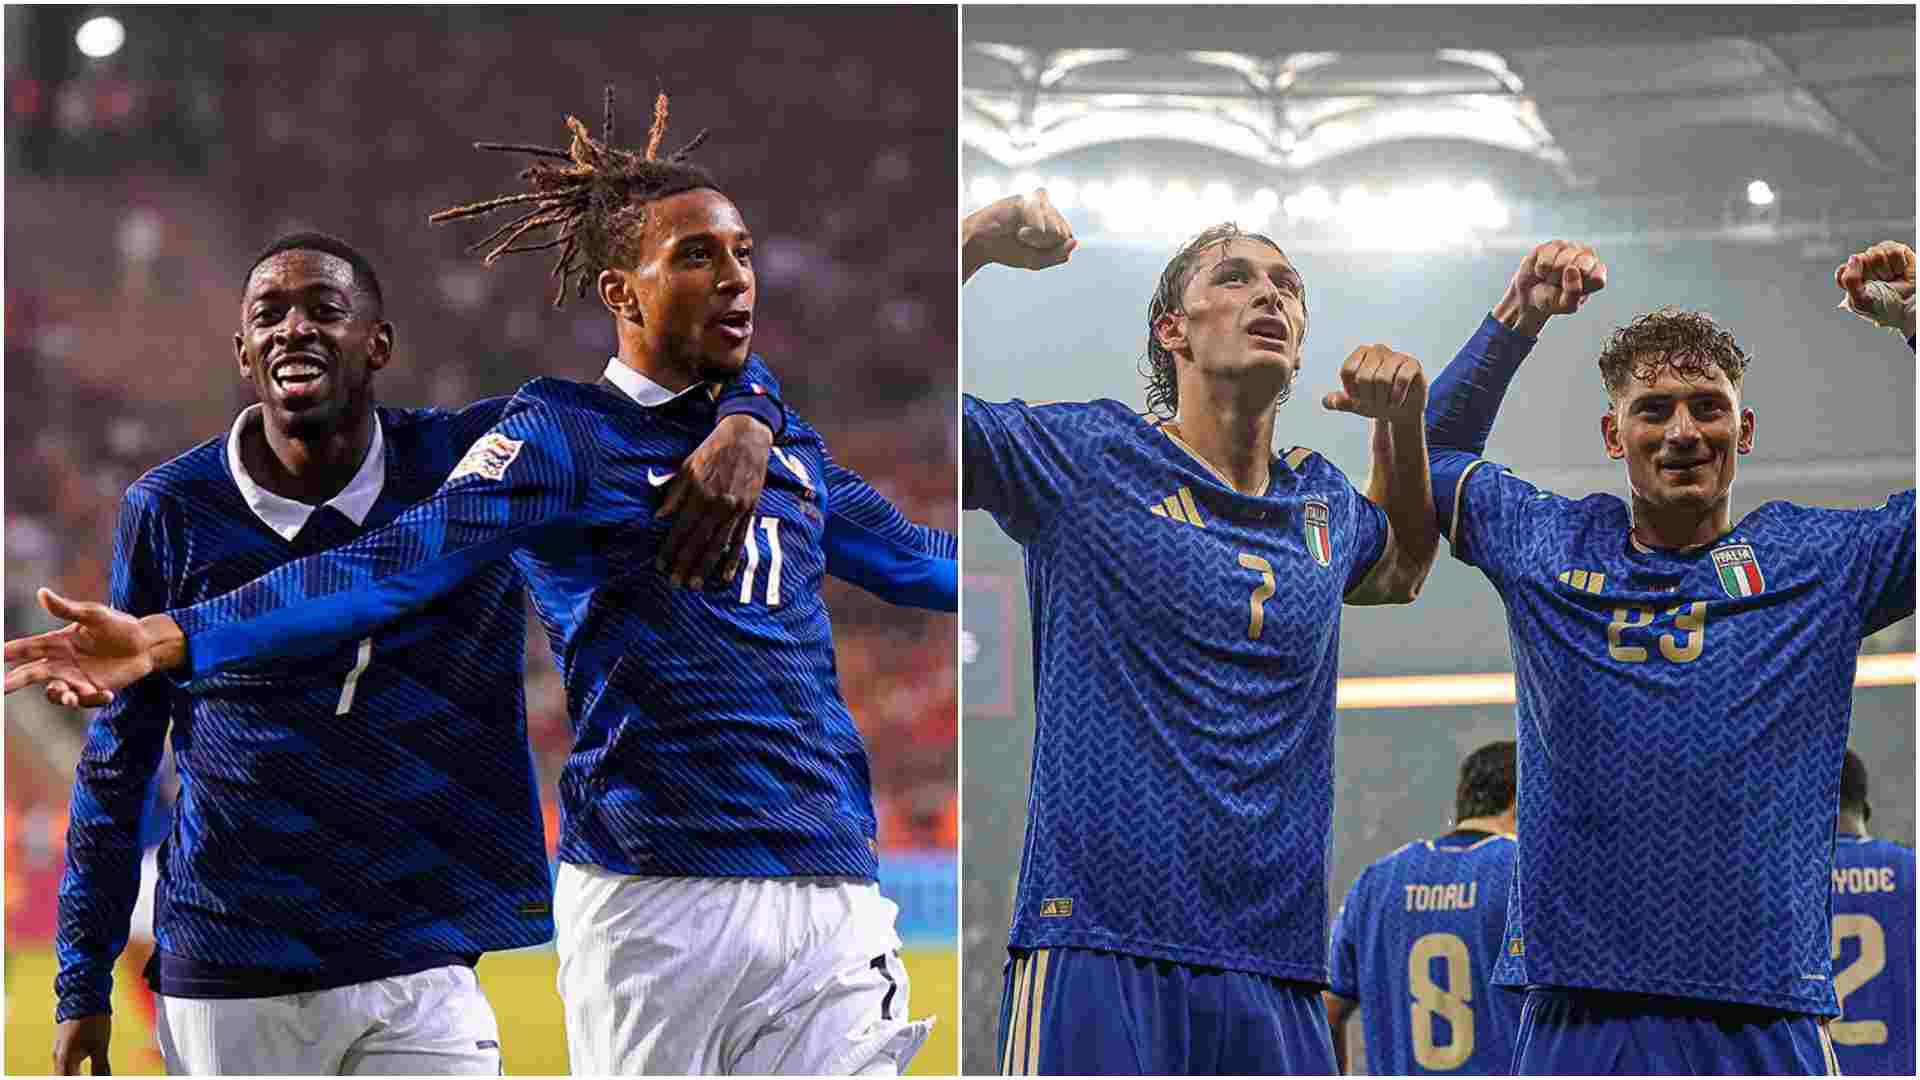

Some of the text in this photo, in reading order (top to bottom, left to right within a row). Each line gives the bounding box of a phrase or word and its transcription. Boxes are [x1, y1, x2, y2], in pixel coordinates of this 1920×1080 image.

[739, 516, 781, 606] 11
[1239, 553, 1276, 640] 7
[1608, 600, 1706, 663] 23
[1404, 881, 1477, 912] TONALI
[1832, 867, 1896, 895] YODE
[1409, 932, 1475, 1071] 8
